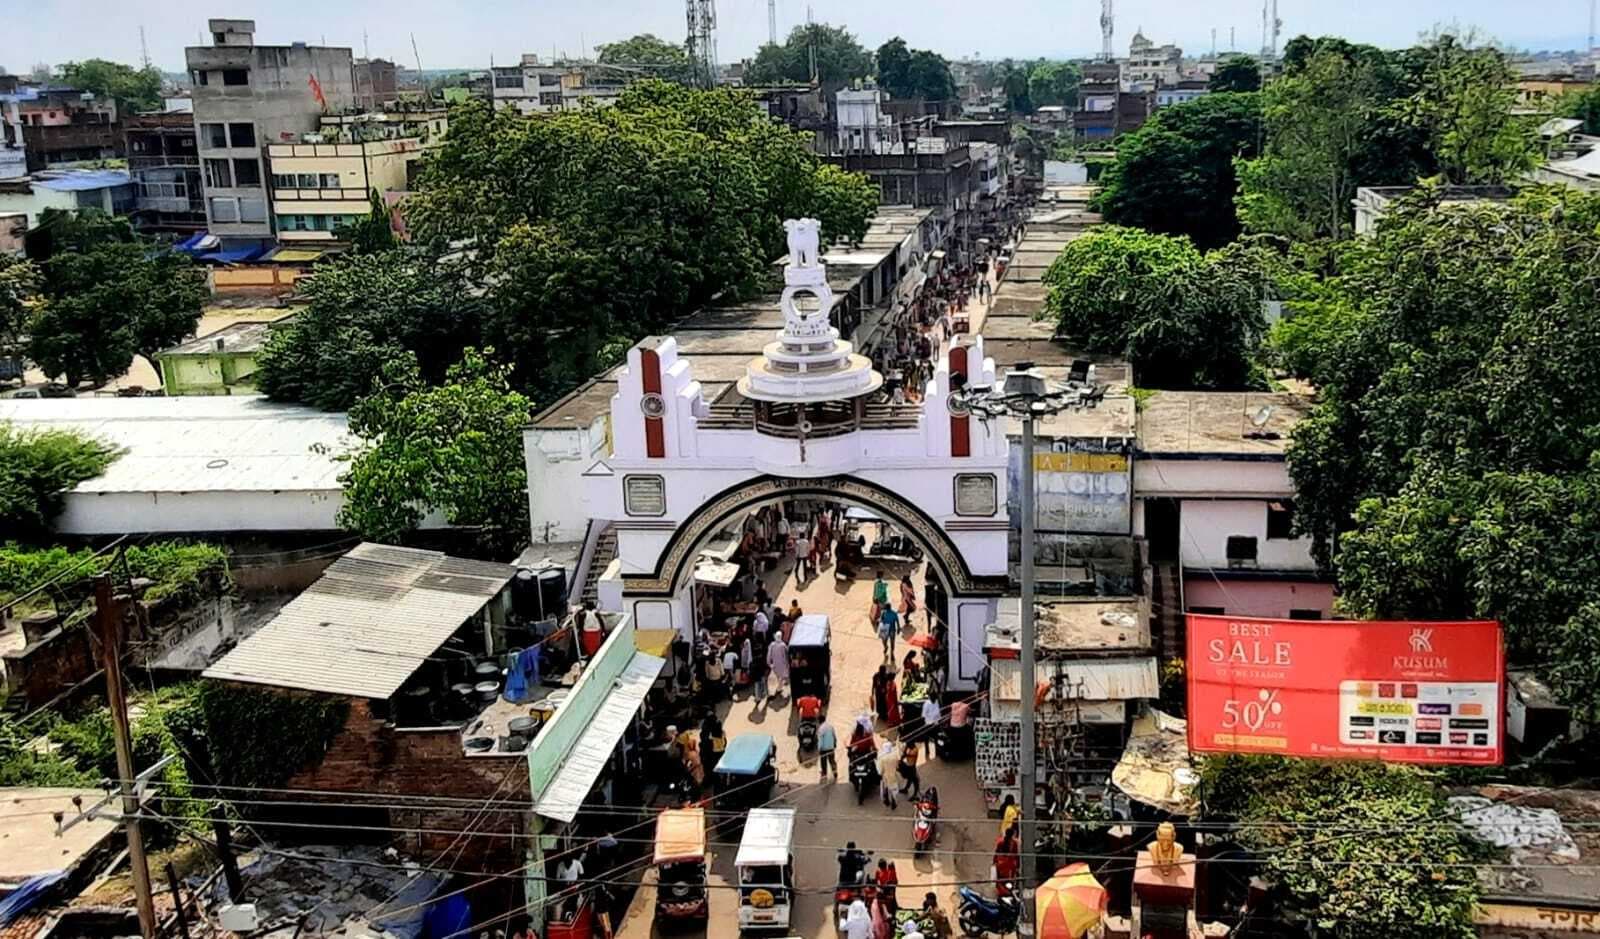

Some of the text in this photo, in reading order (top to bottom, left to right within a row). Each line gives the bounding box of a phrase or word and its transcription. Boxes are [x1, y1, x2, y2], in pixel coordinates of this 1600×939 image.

[1229, 623, 1272, 636] BEST
[1209, 639, 1291, 665] SALE
[1393, 655, 1449, 669] KUSUM
